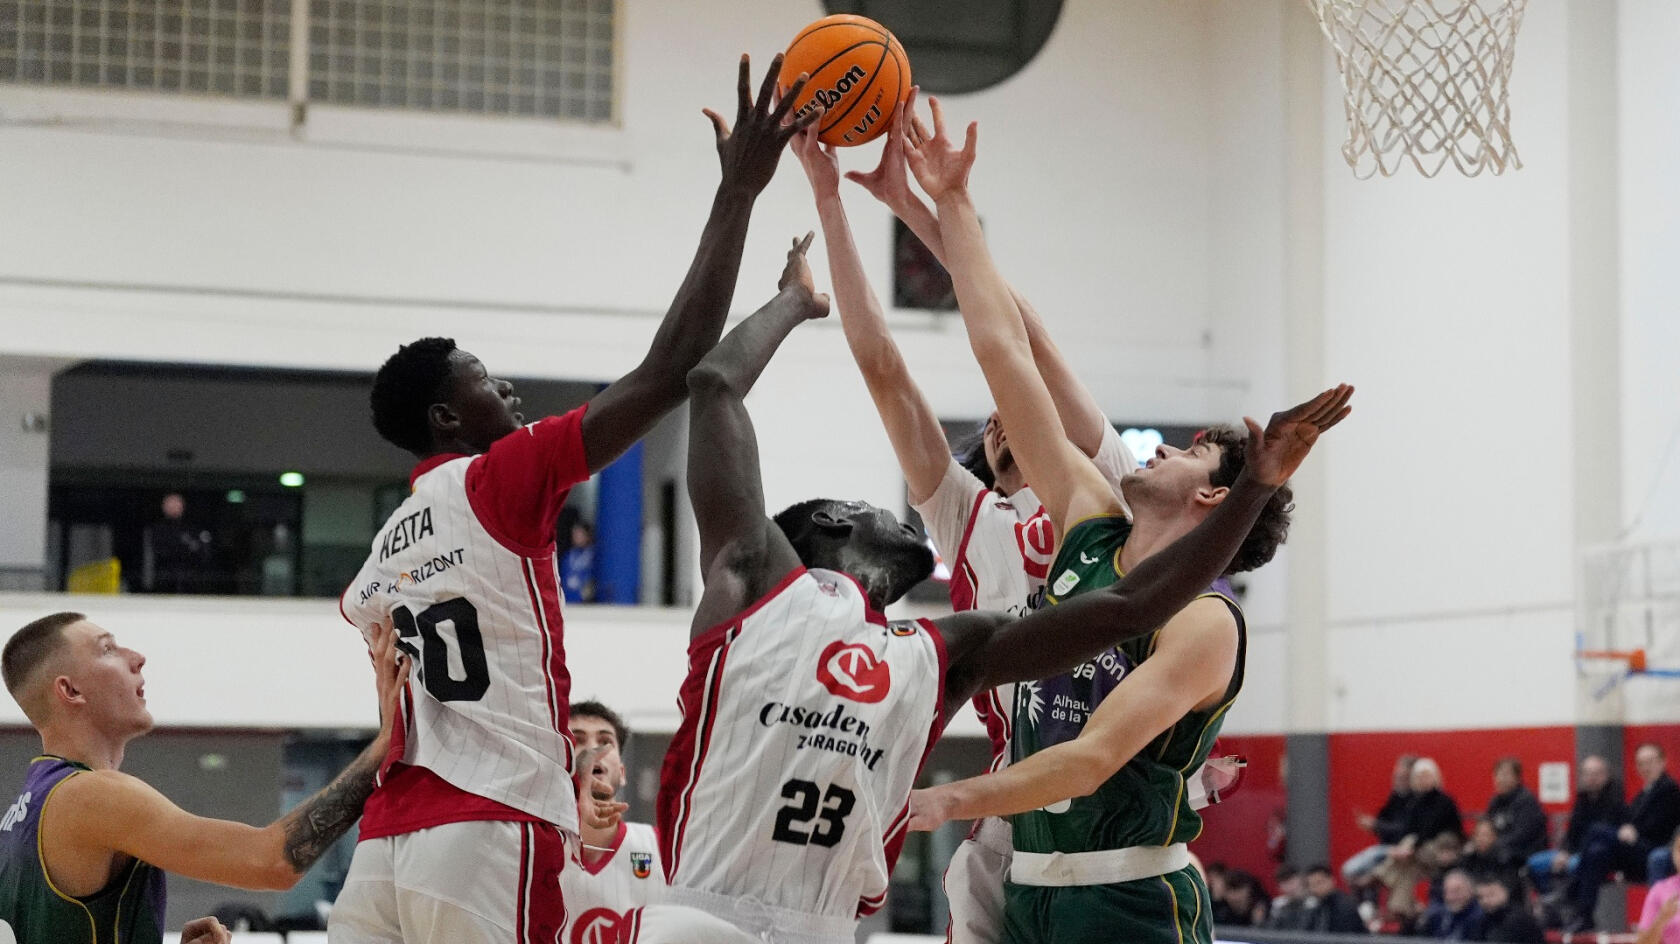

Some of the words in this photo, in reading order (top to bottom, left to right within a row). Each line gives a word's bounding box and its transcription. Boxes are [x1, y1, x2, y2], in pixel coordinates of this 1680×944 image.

[380, 506, 434, 564] KEITA
[360, 581, 381, 604] AIR
[1053, 694, 1090, 711] Alhau
[1051, 707, 1066, 720] de
[1069, 711, 1081, 723] la
[772, 778, 857, 848] 23
